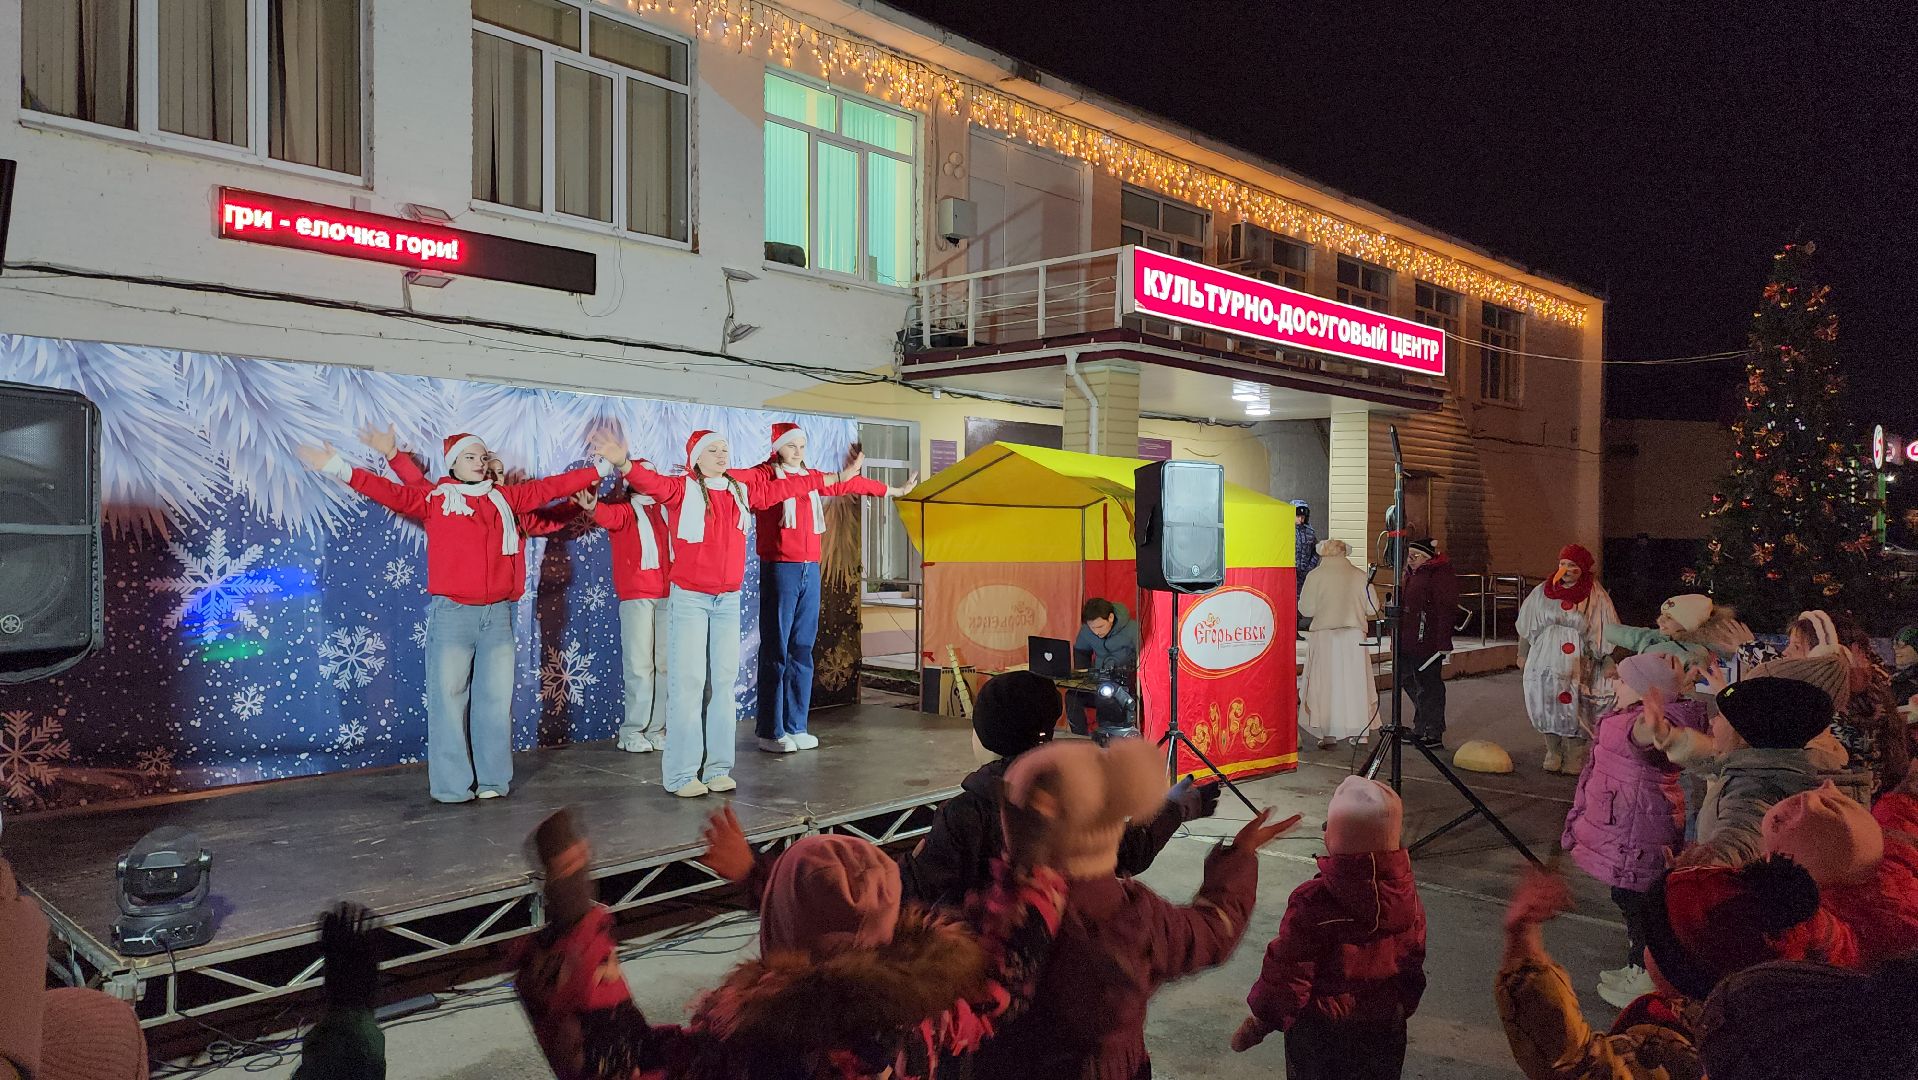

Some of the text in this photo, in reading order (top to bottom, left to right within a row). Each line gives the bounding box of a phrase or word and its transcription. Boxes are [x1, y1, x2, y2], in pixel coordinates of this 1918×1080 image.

[296, 216, 391, 249] елочка
[395, 232, 460, 261] гори!
[1143, 267, 1440, 362] КУЛЬТУРНО-ДОСУГОВЫЙ ЦЕНТР
